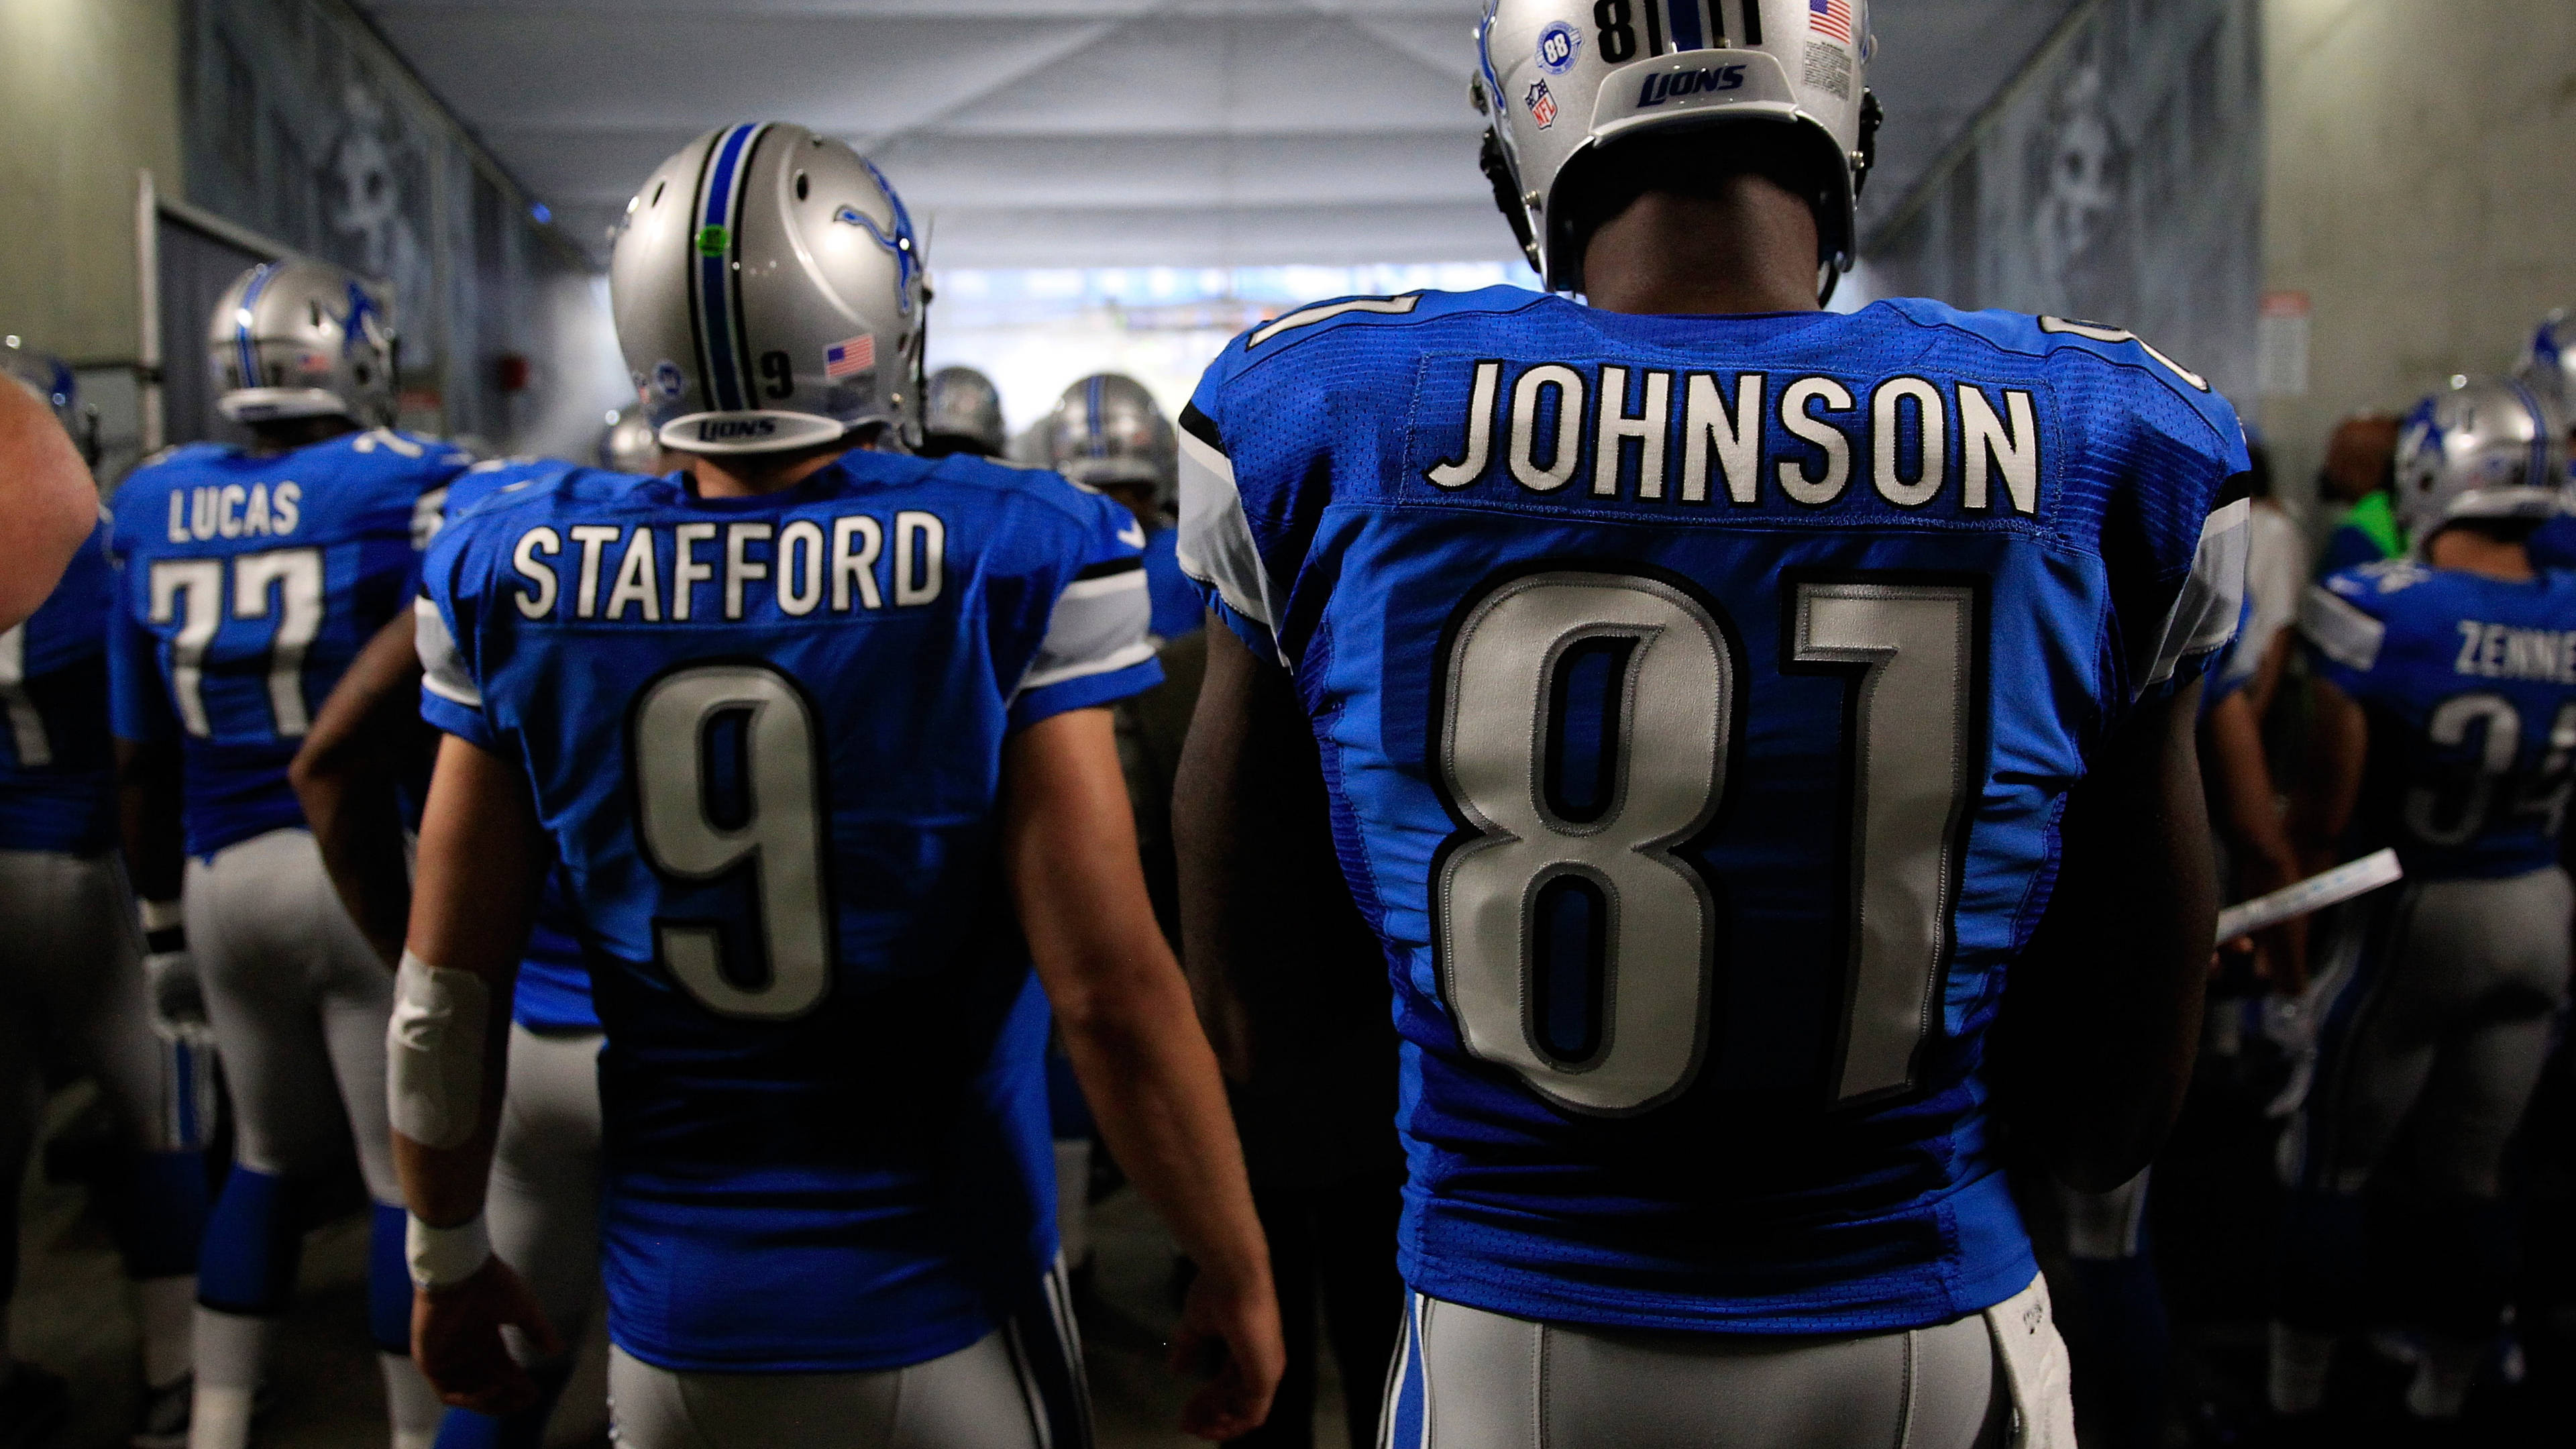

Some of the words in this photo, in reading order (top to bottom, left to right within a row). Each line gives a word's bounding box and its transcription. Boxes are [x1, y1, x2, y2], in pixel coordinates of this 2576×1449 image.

[1544, 33, 1569, 64] 88
[1532, 96, 1556, 126] NFL
[1637, 64, 1748, 108] LIONS
[759, 350, 796, 400] 9
[700, 417, 776, 441] LIONS
[1424, 358, 2040, 518] JOHNSON
[168, 481, 302, 543] LUCAS
[512, 509, 947, 622] STAFFORD
[148, 548, 325, 738] 77
[631, 660, 833, 1022] 9
[1430, 562, 1987, 1116] 81
